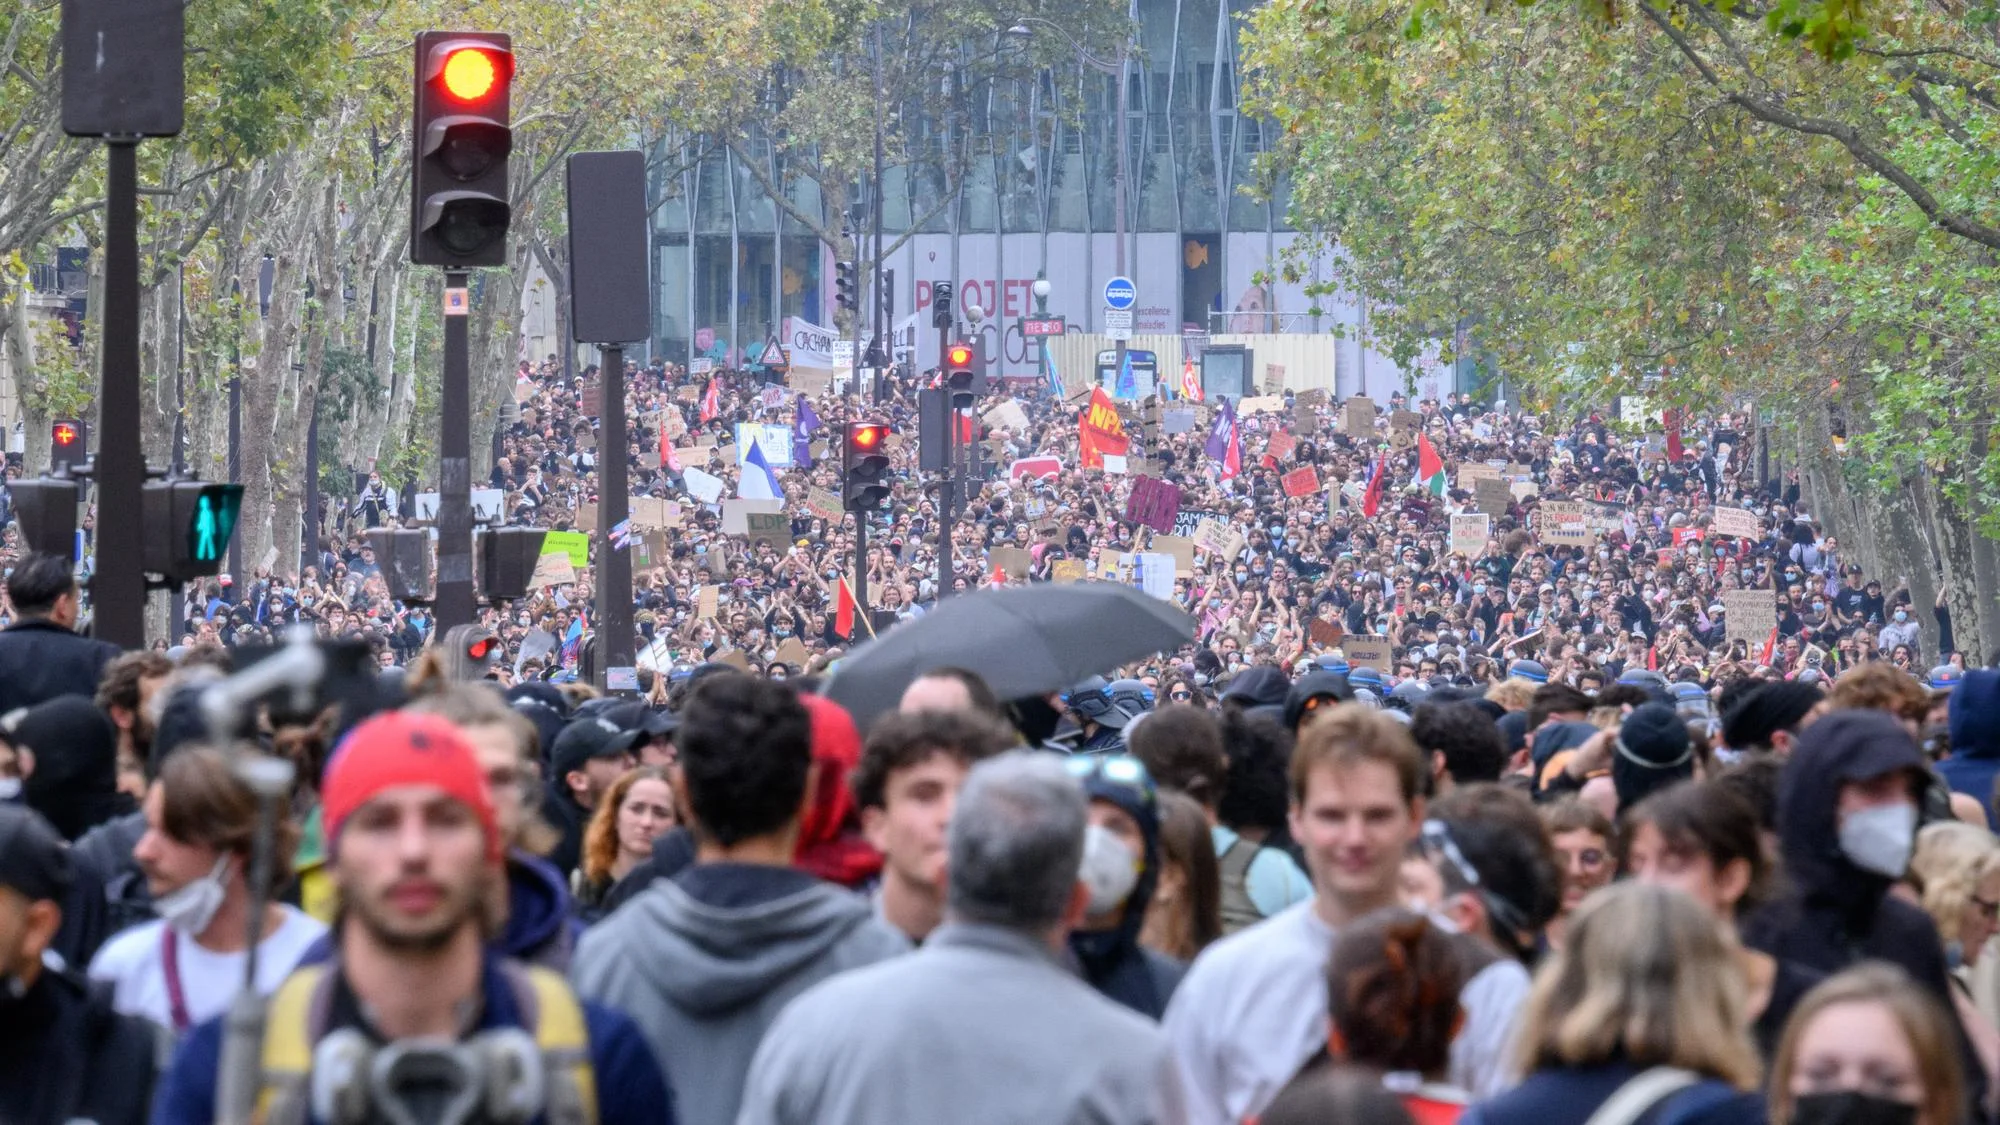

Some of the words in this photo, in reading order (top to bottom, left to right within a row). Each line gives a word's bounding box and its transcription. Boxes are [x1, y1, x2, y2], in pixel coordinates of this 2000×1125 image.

[916, 279, 1035, 317] POJET
[1542, 503, 1555, 513] ON
[1557, 503, 1566, 512] NE
[1567, 503, 1583, 513] FAIT
